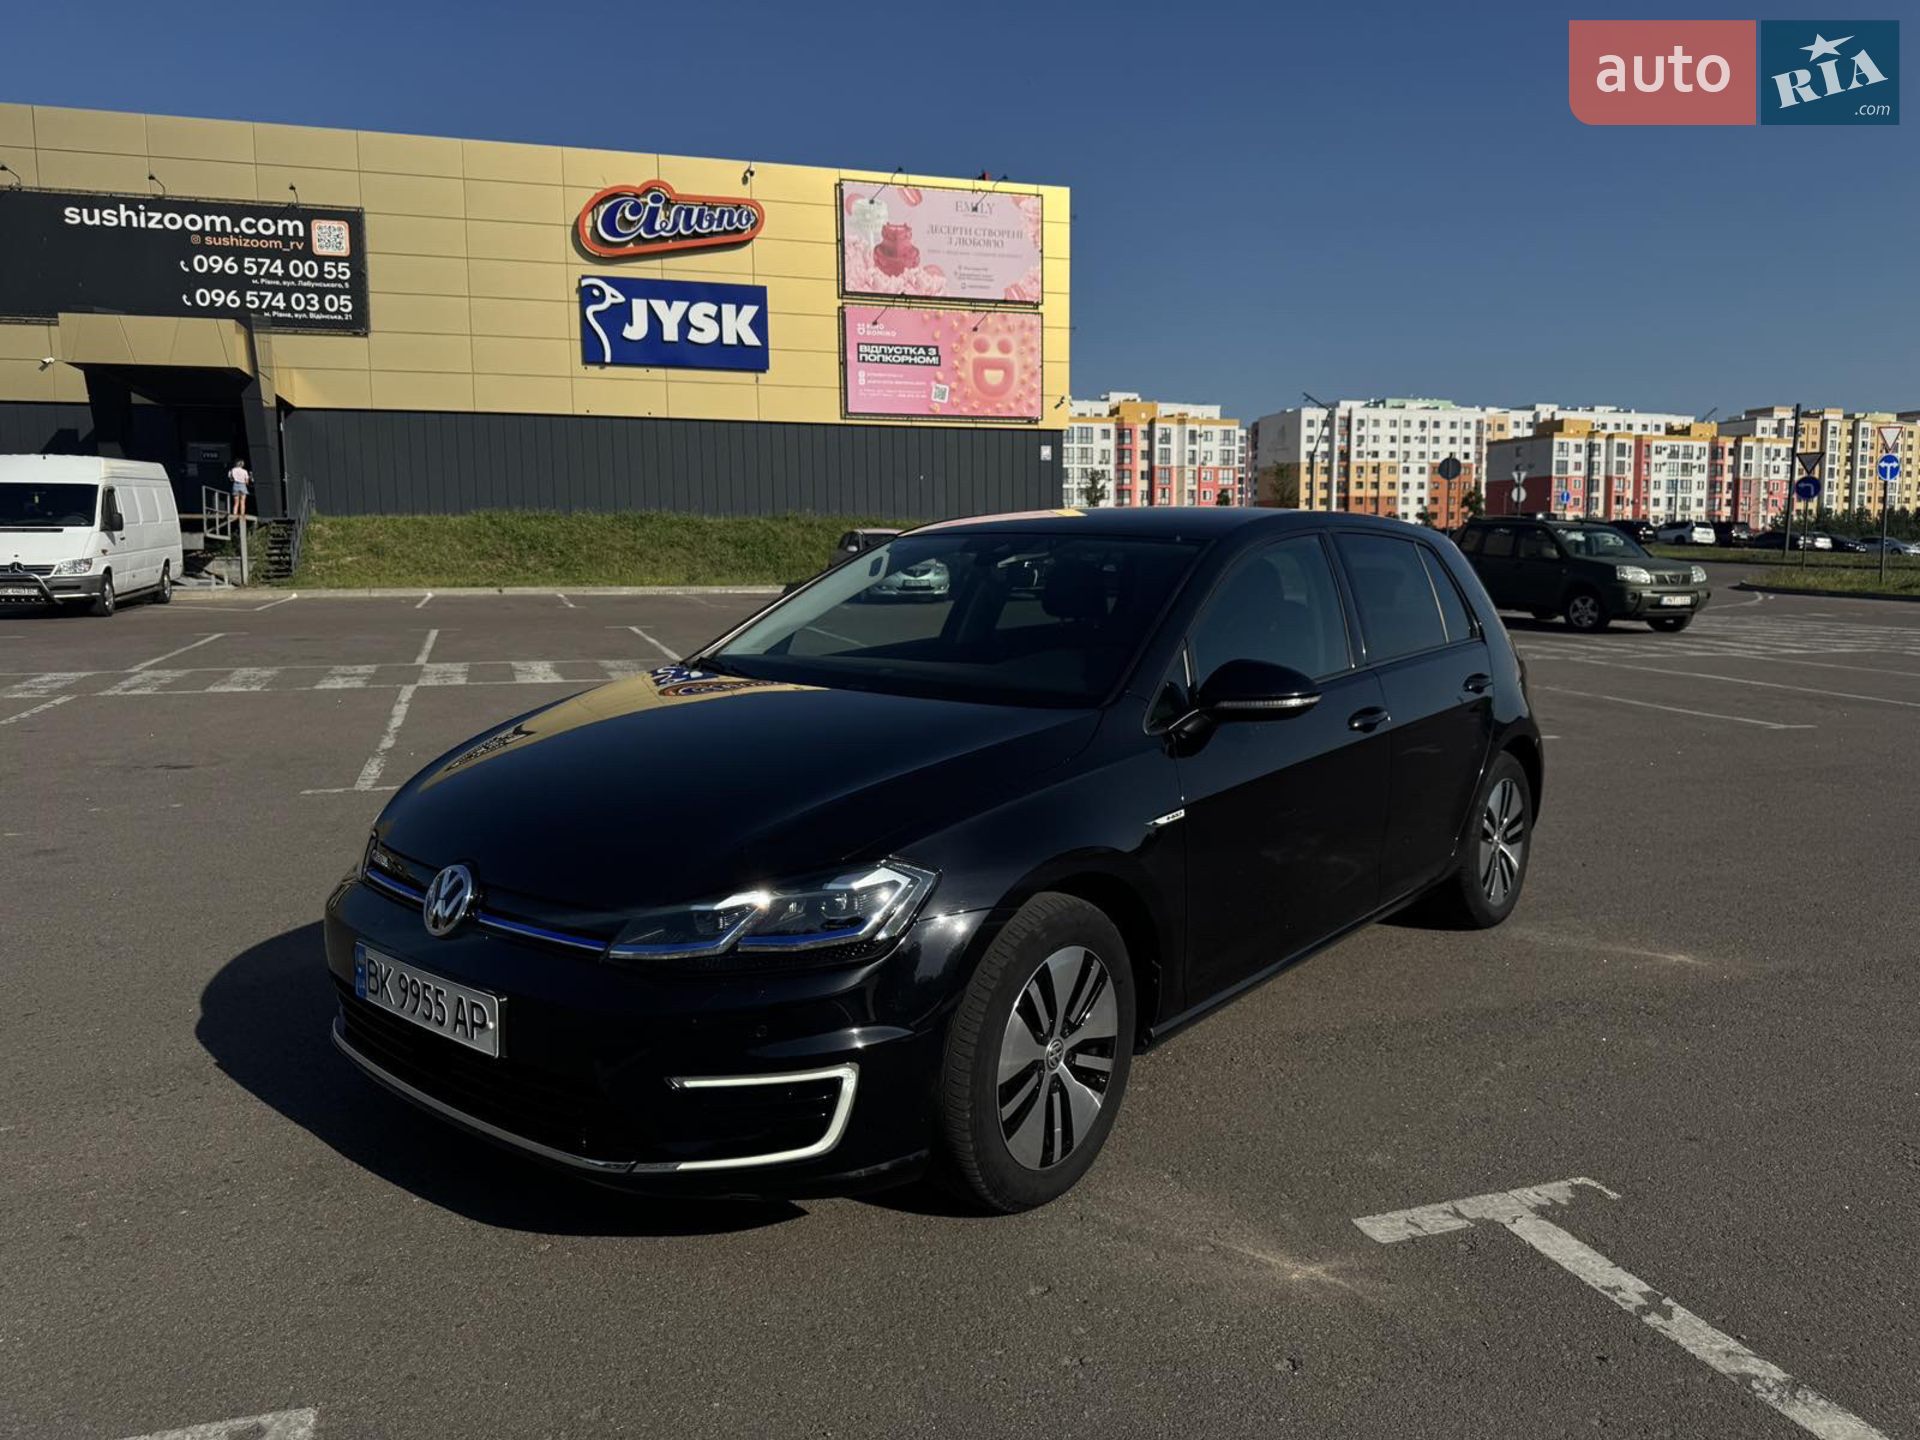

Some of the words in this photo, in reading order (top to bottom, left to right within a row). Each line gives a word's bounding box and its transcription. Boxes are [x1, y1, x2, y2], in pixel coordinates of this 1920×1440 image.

[63, 203, 305, 238] sushizoom.com
[597, 191, 756, 243] Сільпо
[204, 234, 305, 252] sushizoom_rv
[193, 254, 239, 275] 096
[243, 257, 285, 277] 574
[288, 259, 319, 279] 00
[323, 261, 352, 280] 55
[195, 288, 241, 308] 096
[245, 291, 287, 311] 574
[290, 292, 320, 312] 03
[324, 294, 353, 313] 05
[622, 298, 762, 347] JYSK
[859, 344, 926, 356] ВІДПУСТКА
[859, 353, 939, 365] ПОПКОРНОМ!
[367, 957, 396, 1006] BK
[398, 971, 449, 1028] 9955
[453, 994, 490, 1041] AP
